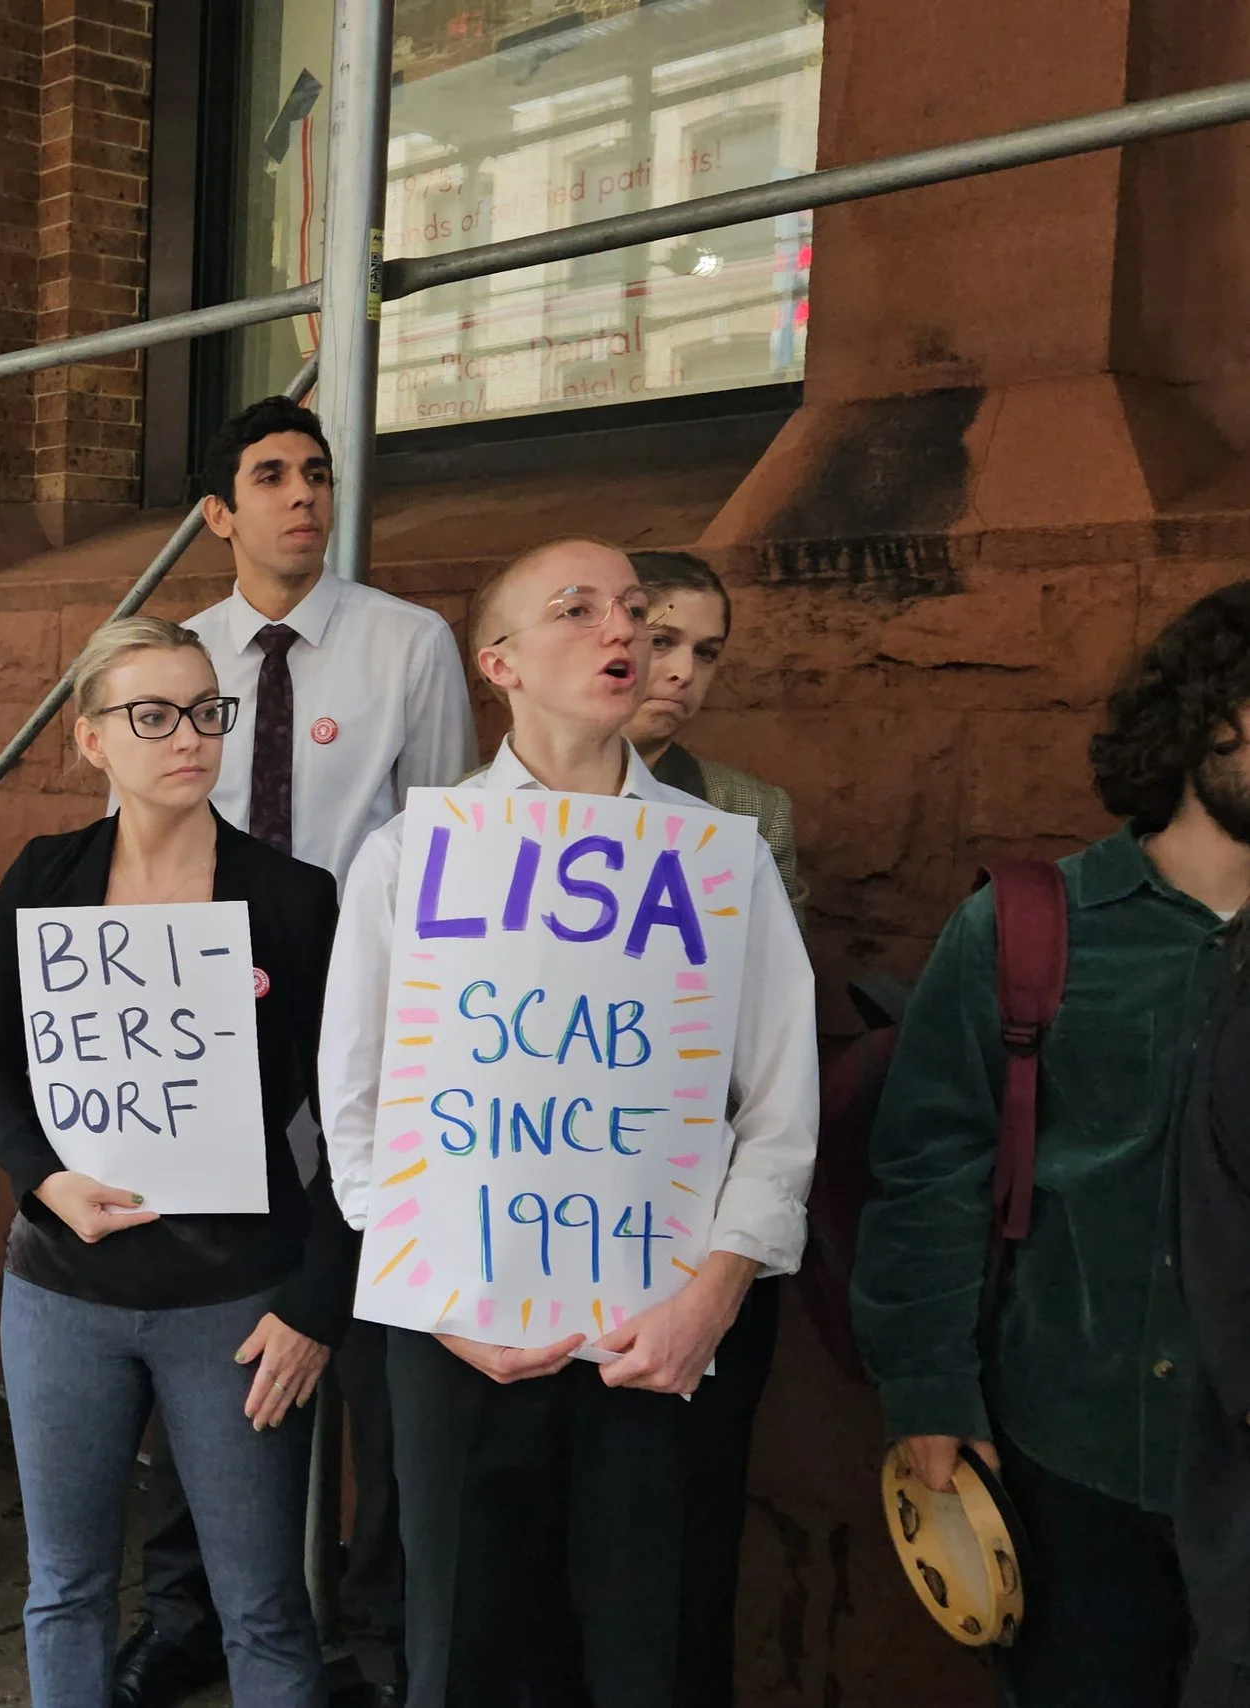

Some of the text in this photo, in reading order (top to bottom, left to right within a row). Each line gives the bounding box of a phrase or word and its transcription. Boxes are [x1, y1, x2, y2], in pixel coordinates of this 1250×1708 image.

[462, 201, 483, 232] of
[598, 139, 722, 204] patits!
[415, 826, 707, 965] LISA
[38, 920, 230, 992] BRI-
[30, 1007, 236, 1064] BERS-
[458, 980, 652, 1069] SCAB
[49, 1079, 198, 1138] DORF
[430, 1088, 670, 1159] SINCE
[478, 1184, 674, 1290] 1994
